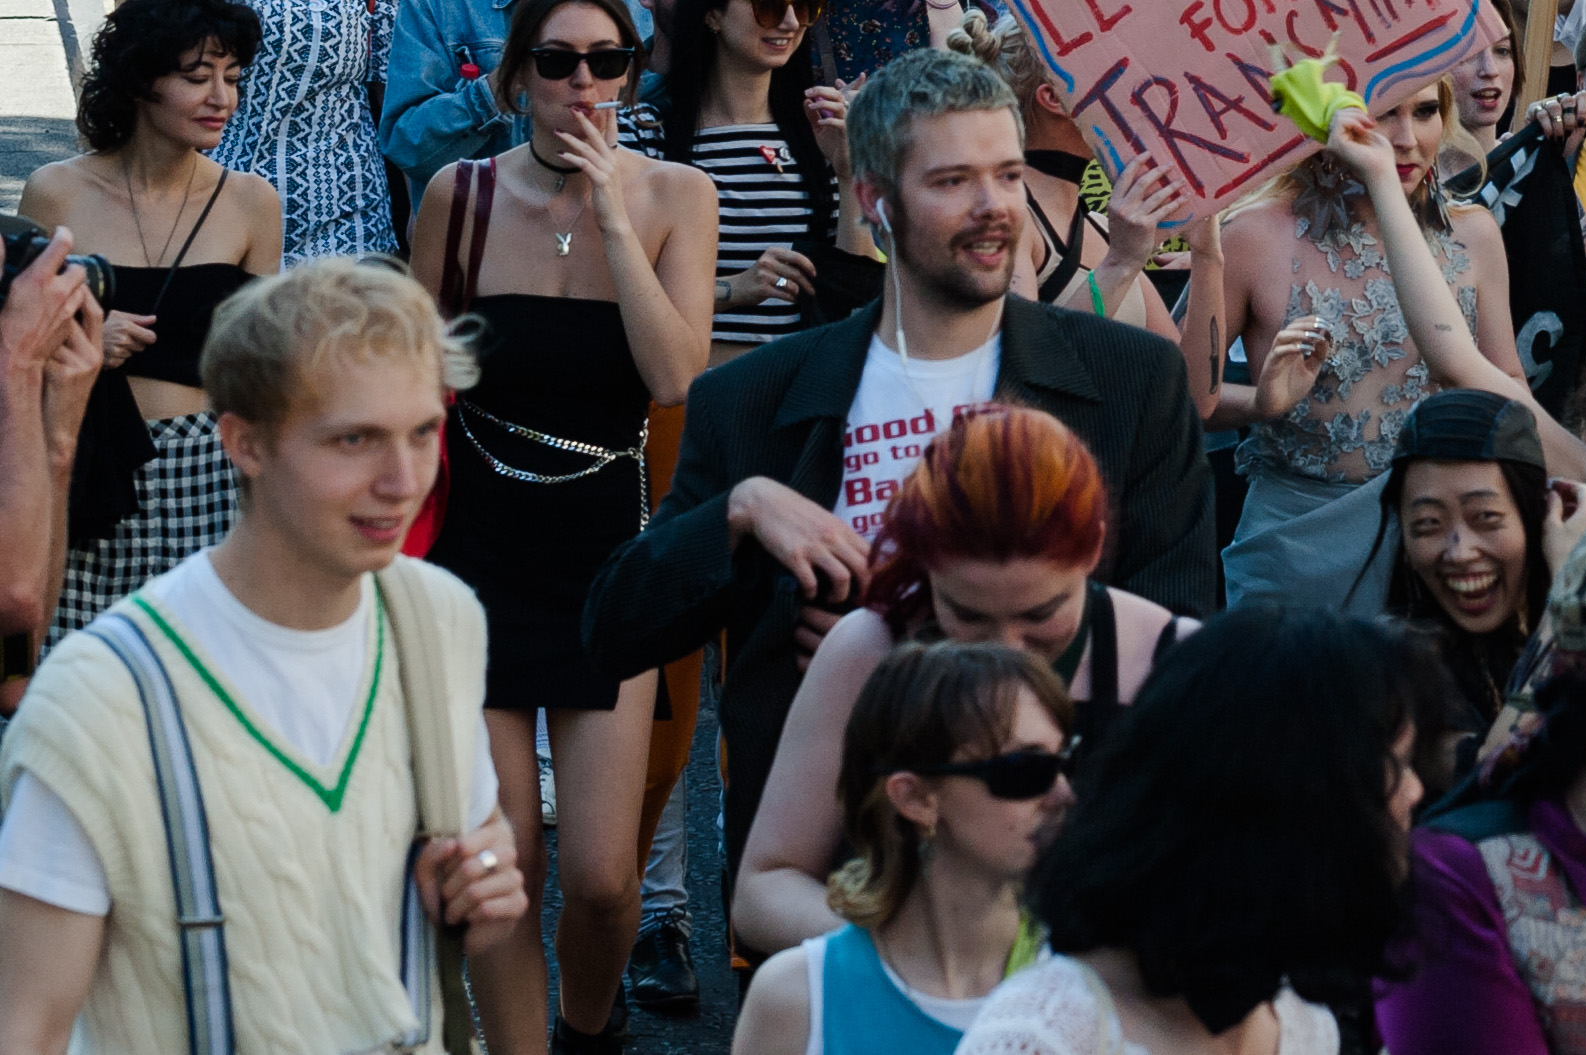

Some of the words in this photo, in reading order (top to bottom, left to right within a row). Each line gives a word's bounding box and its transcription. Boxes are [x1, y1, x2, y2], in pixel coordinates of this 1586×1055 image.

[844, 452, 879, 473] go
[890, 445, 920, 460] to
[844, 477, 899, 507] Ba
